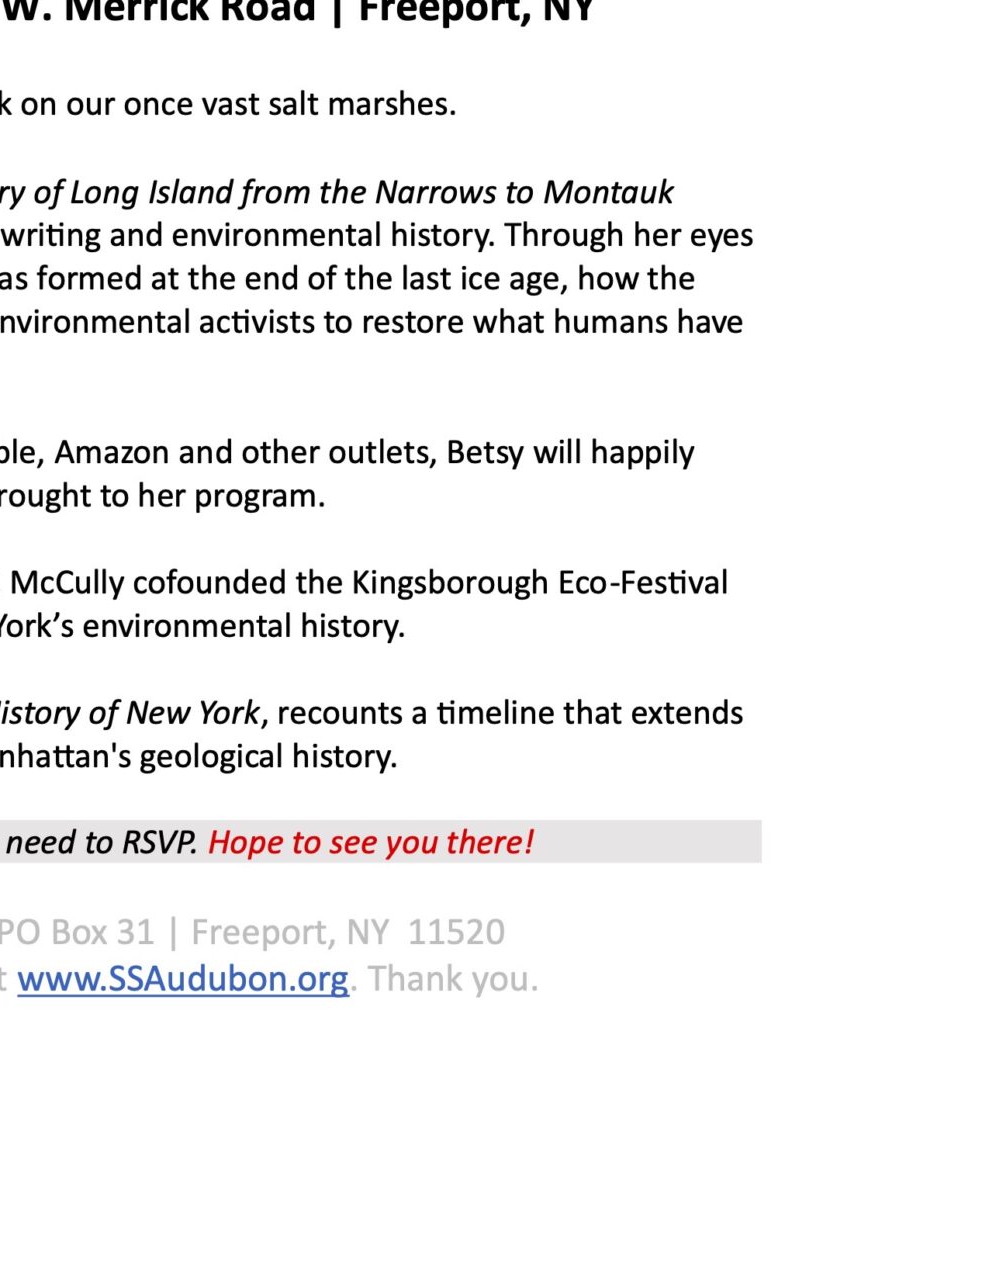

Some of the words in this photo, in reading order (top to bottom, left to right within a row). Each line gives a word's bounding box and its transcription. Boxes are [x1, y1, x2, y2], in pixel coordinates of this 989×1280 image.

[21, 97, 55, 115] on
[67, 97, 116, 115] our
[124, 97, 193, 116] once
[202, 93, 259, 116] vast
[269, 90, 318, 116] salt
[329, 90, 455, 116] marshes.
[34, 178, 67, 210] of
[71, 180, 139, 210] Long
[149, 178, 234, 205] Island
[241, 178, 310, 210] from
[320, 178, 366, 204] the
[376, 180, 497, 204] Narrows
[506, 182, 533, 204] to
[544, 178, 675, 204] Montauk
[12, 568, 125, 600] McCully
[134, 568, 285, 594] cofounded
[296, 568, 342, 594] the
[354, 568, 547, 600] Kingsborough
[560, 568, 727, 594] Eco-Festival
[83, 612, 290, 638] environmental
[302, 612, 404, 643] history.
[6, 828, 77, 854] need
[86, 832, 113, 854] to
[123, 830, 196, 854] RSVP.
[209, 830, 283, 860] Hope
[293, 832, 321, 854] to
[329, 836, 377, 854] see
[385, 836, 438, 860] you
[447, 828, 534, 854] there!
[0, 920, 39, 944] PO
[54, 920, 105, 944] Box
[119, 920, 153, 944] 31
[194, 920, 334, 950] Freeport,
[349, 920, 388, 944] NY
[411, 920, 503, 944] 11520
[368, 965, 461, 990] Thank
[473, 973, 536, 997] you.
